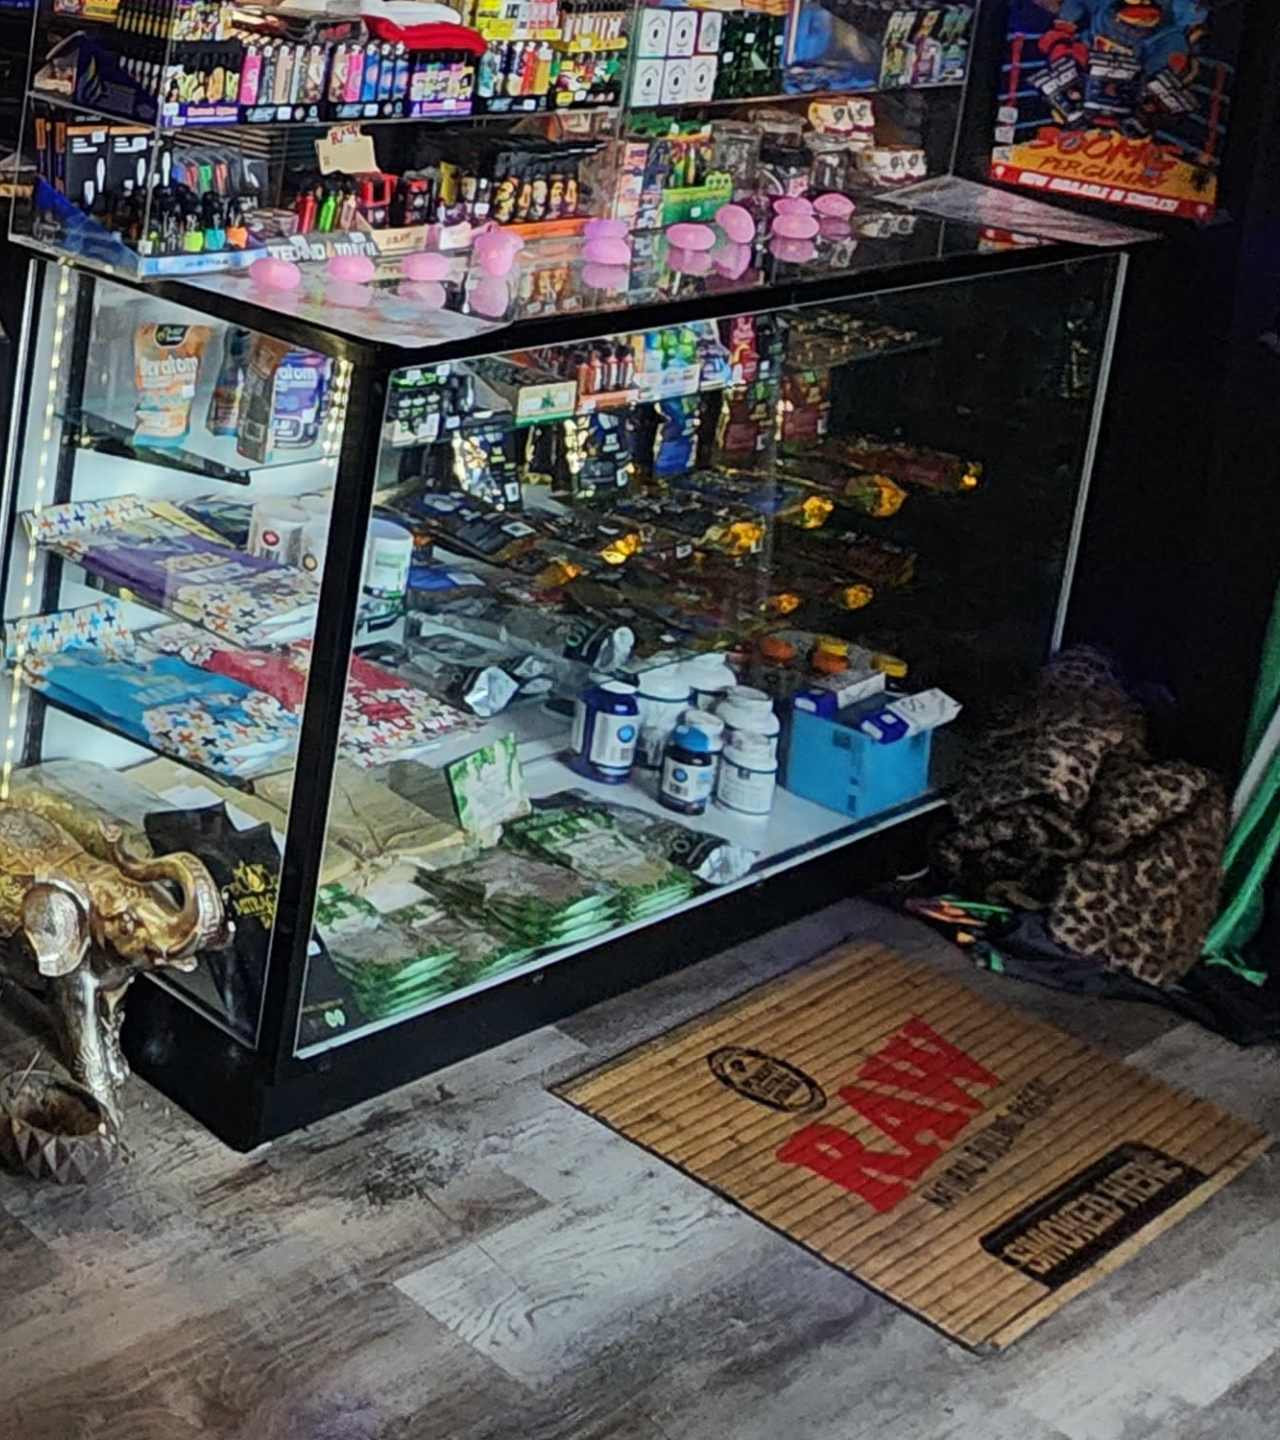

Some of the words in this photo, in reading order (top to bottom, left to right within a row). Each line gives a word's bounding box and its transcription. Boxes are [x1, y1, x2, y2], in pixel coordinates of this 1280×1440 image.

[774, 1013, 1001, 1215] RAW
[1003, 1192, 1119, 1275] SMOKED
[1099, 1146, 1186, 1216] HERE
